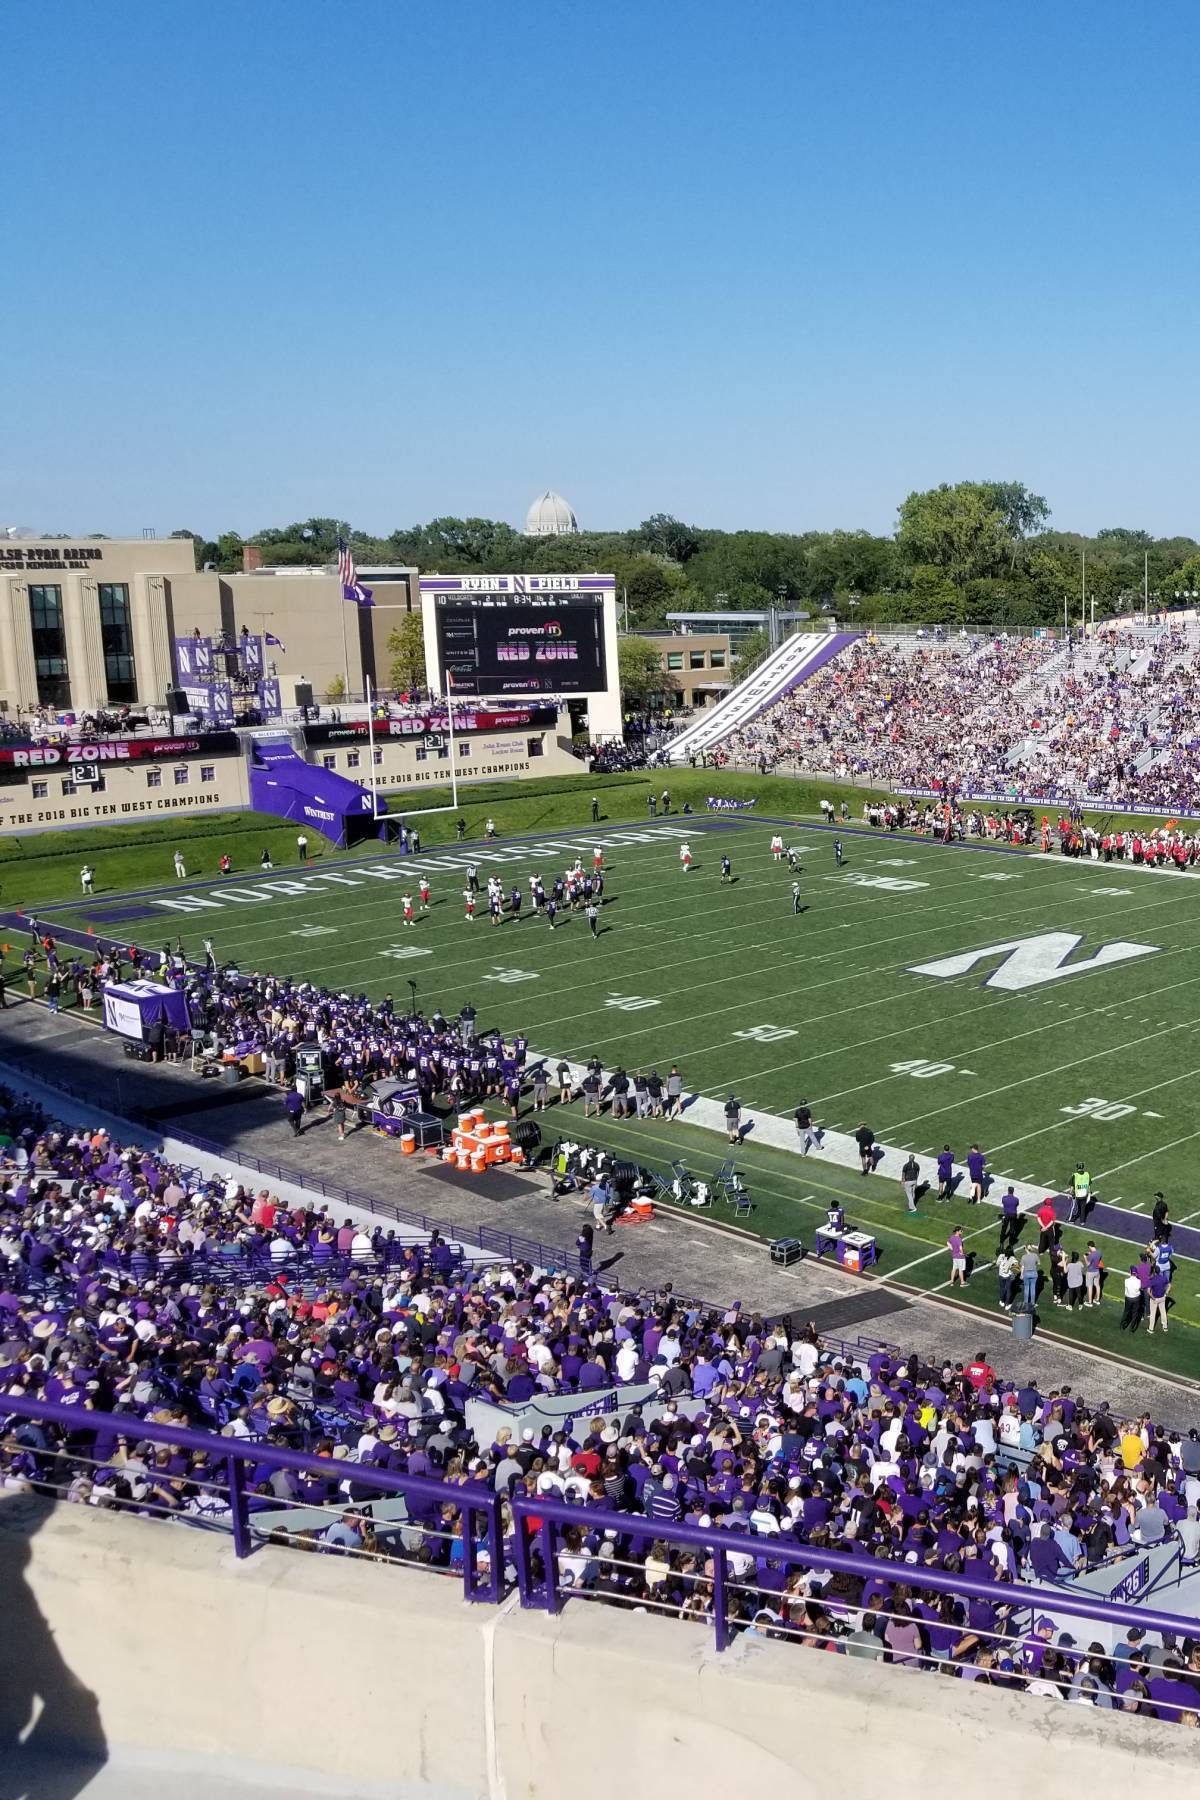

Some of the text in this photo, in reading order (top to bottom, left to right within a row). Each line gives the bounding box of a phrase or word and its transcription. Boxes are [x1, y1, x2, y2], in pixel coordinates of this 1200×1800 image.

[64, 548, 102, 560] ARENA
[461, 578, 500, 591] RYAN
[514, 576, 526, 592] N
[538, 578, 579, 590] FIELD
[439, 596, 446, 605] 10
[514, 595, 531, 604] 8:34
[594, 595, 602, 603] 14
[508, 627, 544, 636] proven
[196, 648, 209, 666] N
[246, 646, 258, 664] N
[496, 641, 578, 660] RED ZONE
[178, 646, 190, 673] N
[214, 692, 228, 710] N
[264, 690, 276, 708] N
[389, 716, 477, 735] RED ZONE
[328, 729, 356, 738] proven
[427, 735, 441, 746] 27
[154, 743, 185, 751] proven
[13, 743, 130, 767] RED ZONE
[77, 766, 95, 780] 27
[391, 774, 411, 783] 2018
[415, 772, 430, 781] BIG
[434, 769, 450, 779] TEN
[455, 767, 478, 777] WEST
[482, 762, 530, 774] CHAMPIONS
[10, 814, 32, 825] THE
[38, 811, 65, 822] 2018
[71, 808, 89, 818] BIG
[94, 805, 117, 815] TEN
[121, 800, 152, 812] WEST
[157, 794, 220, 808] CHAMPIONS
[361, 795, 372, 810] N
[304, 806, 335, 821] WINTRUST
[150, 827, 706, 912] NORTHWESTERN
[290, 926, 338, 937] 10
[377, 947, 433, 958] 20
[905, 931, 1162, 990] N
[482, 969, 540, 983] 30
[603, 996, 662, 1010] 40
[732, 1024, 799, 1042] 50
[888, 1059, 956, 1078] 40
[1060, 1098, 1137, 1120] 30
[496, 1146, 504, 1155] G
[1000, 1423, 1010, 1433] 43
[1026, 1650, 1034, 1663] 7
